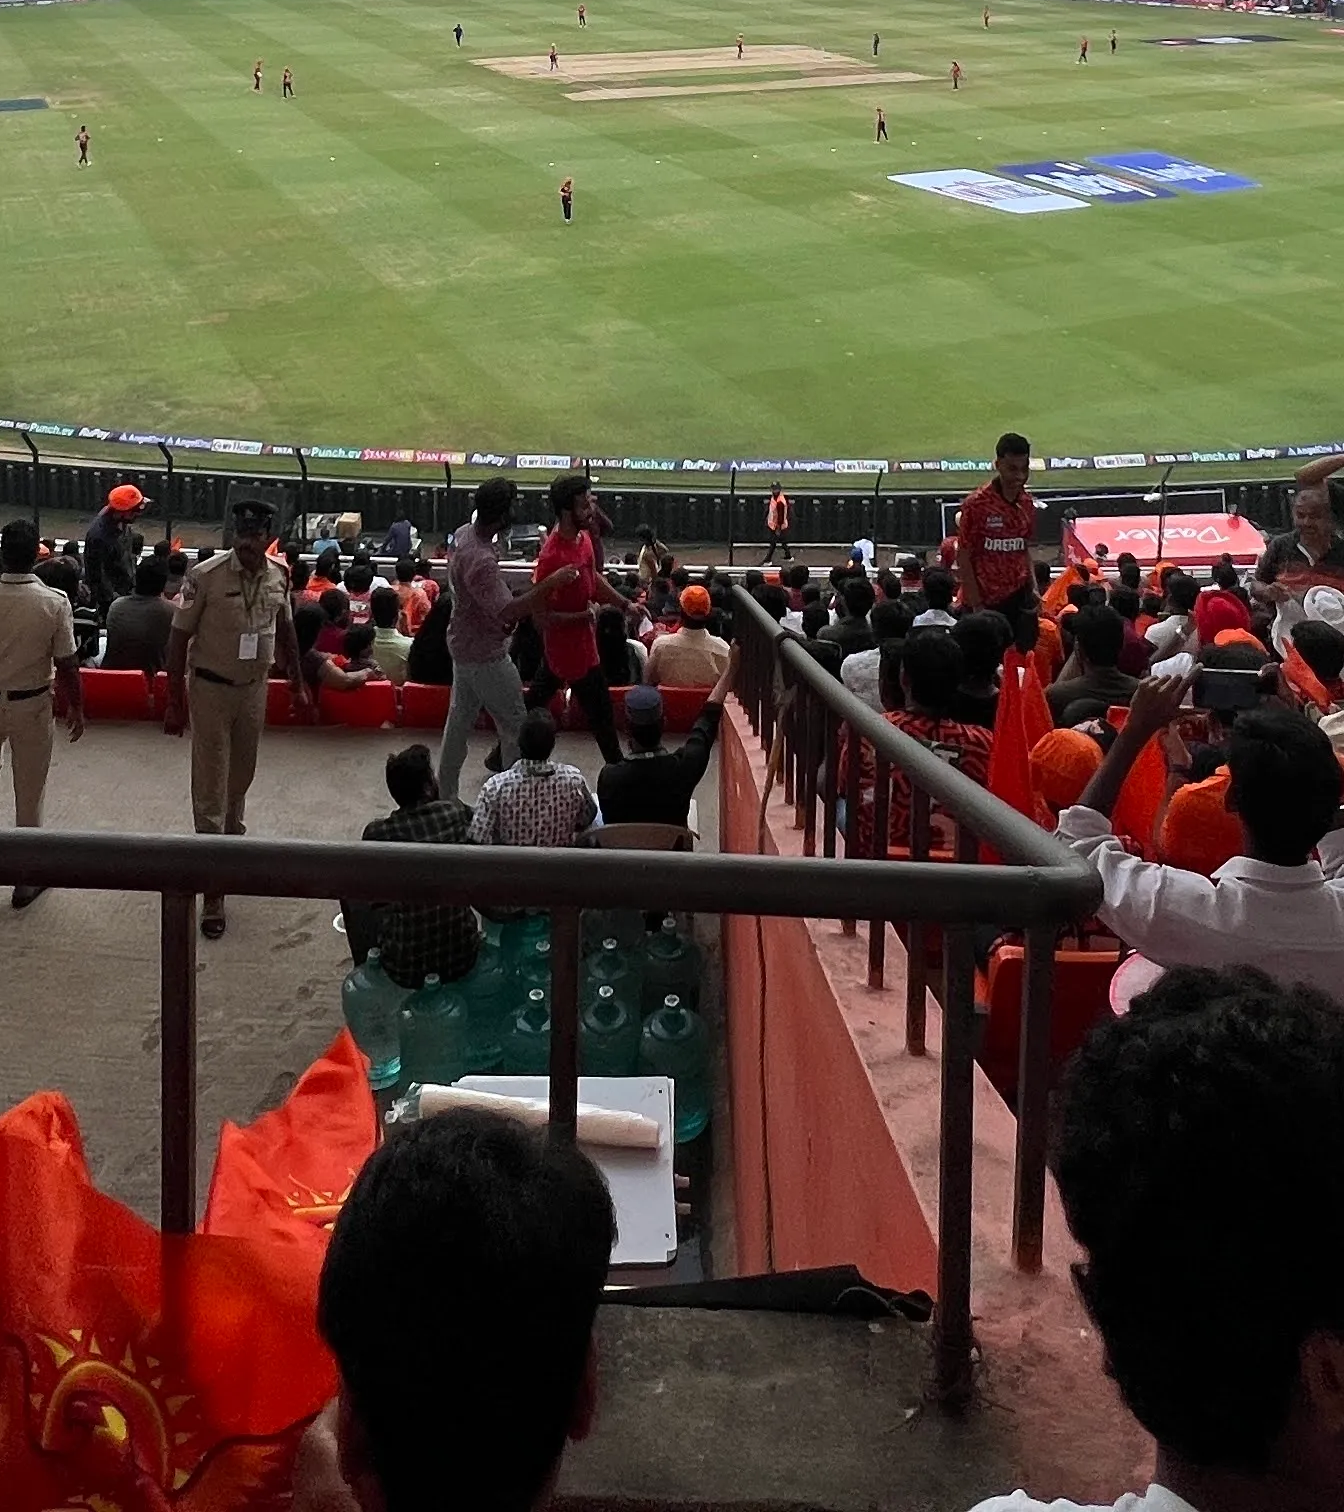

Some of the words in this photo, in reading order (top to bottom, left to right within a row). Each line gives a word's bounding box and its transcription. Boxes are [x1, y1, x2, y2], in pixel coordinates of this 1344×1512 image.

[29, 422, 76, 437] Punch.ev
[272, 446, 293, 455] TATA
[311, 447, 362, 460] Punch.ev
[1246, 448, 1277, 460] RuPay
[1297, 445, 1333, 455] AngelOne
[471, 453, 506, 466] RuPay
[1191, 451, 1241, 462] Punch.ev
[622, 458, 676, 470] Punch.ev
[682, 459, 717, 472] RuPay
[740, 460, 781, 471] AngelOne
[793, 460, 835, 471] AngelOne
[899, 462, 922, 471] TATA
[940, 460, 992, 471] Punch.ev
[1050, 457, 1083, 469] RuPay
